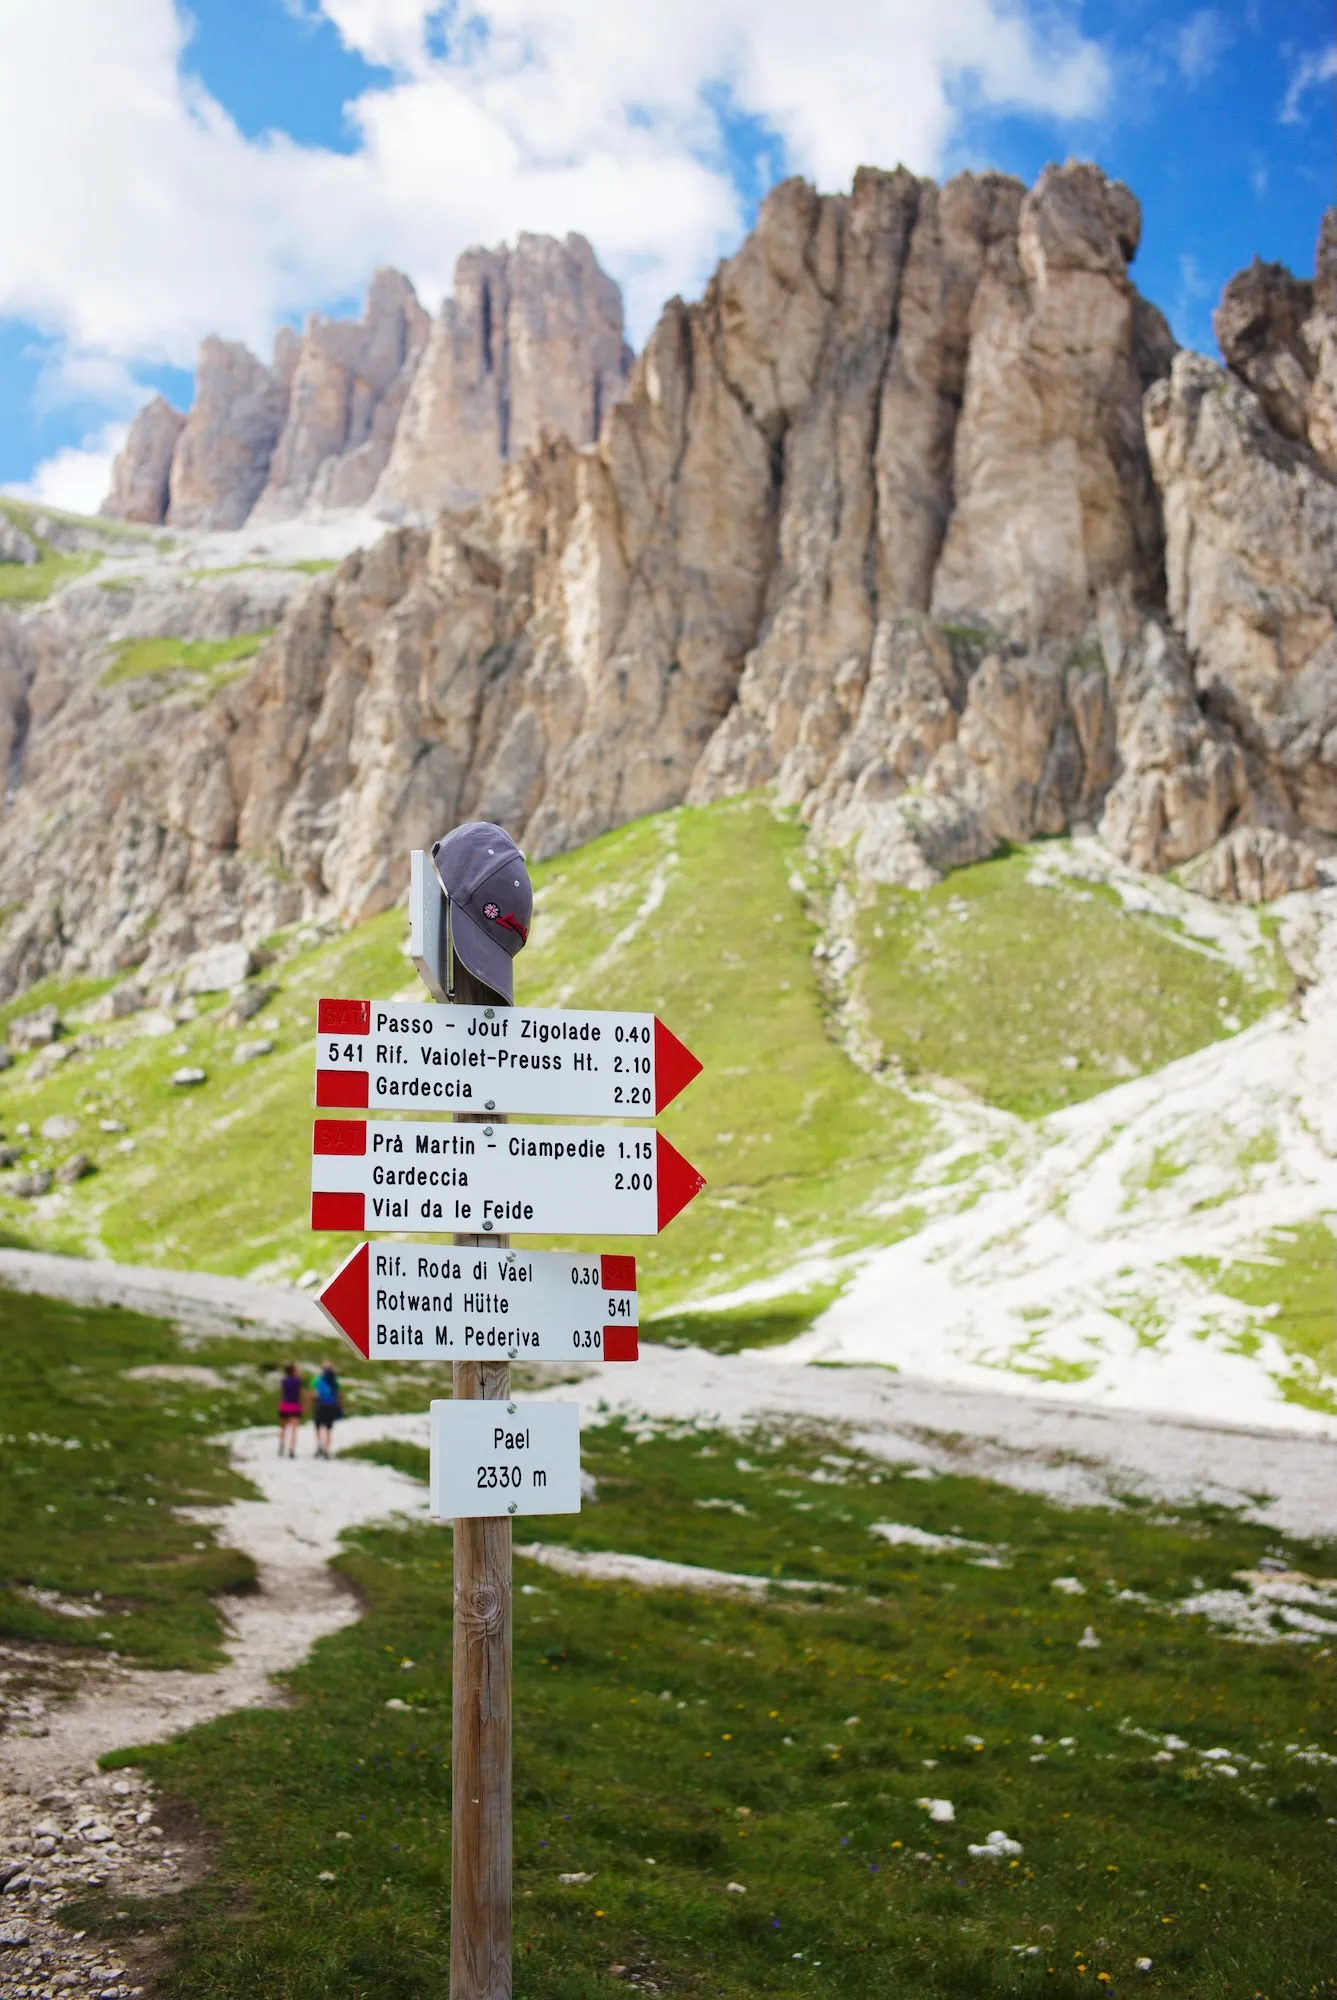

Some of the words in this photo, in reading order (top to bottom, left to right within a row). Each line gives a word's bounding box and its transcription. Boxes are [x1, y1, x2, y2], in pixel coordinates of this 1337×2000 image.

[377, 1013, 434, 1035] Passo
[467, 1018, 509, 1038] Jouf
[520, 1019, 601, 1044] Zigolade
[614, 1025, 651, 1044] 0.40
[328, 1042, 363, 1063] 541
[376, 1044, 408, 1065] Rif.
[420, 1046, 562, 1071] Vaiolet-Preuss
[573, 1052, 599, 1072] Ht.
[613, 1055, 651, 1074] 2.10
[375, 1075, 473, 1098] Gardeccia
[614, 1086, 652, 1105] 2.20
[320, 1127, 361, 1148] SAT
[373, 1133, 404, 1154] Prà
[415, 1134, 475, 1155] Martin
[508, 1136, 606, 1161] Ciampedie
[618, 1141, 653, 1160] 1.15
[372, 1165, 469, 1187] Gardeccia
[614, 1172, 653, 1191] 2.00
[372, 1197, 409, 1218] Vial
[420, 1198, 443, 1219] da
[455, 1199, 472, 1219] le
[483, 1199, 534, 1220] Feide
[376, 1255, 407, 1277] Rif.
[417, 1257, 462, 1280] Roda
[472, 1260, 488, 1281] di
[497, 1260, 533, 1283] Vael
[571, 1266, 600, 1286] 0.30
[376, 1289, 453, 1313] Rotwand
[463, 1292, 509, 1314] Hütte
[607, 1297, 631, 1318] 541
[376, 1323, 424, 1346] Baita
[435, 1325, 454, 1346] M.
[464, 1325, 541, 1348] Pederiva
[572, 1329, 601, 1349] 0.30
[494, 1427, 530, 1450] Pael
[476, 1465, 522, 1489] 2330
[532, 1469, 547, 1488] m
